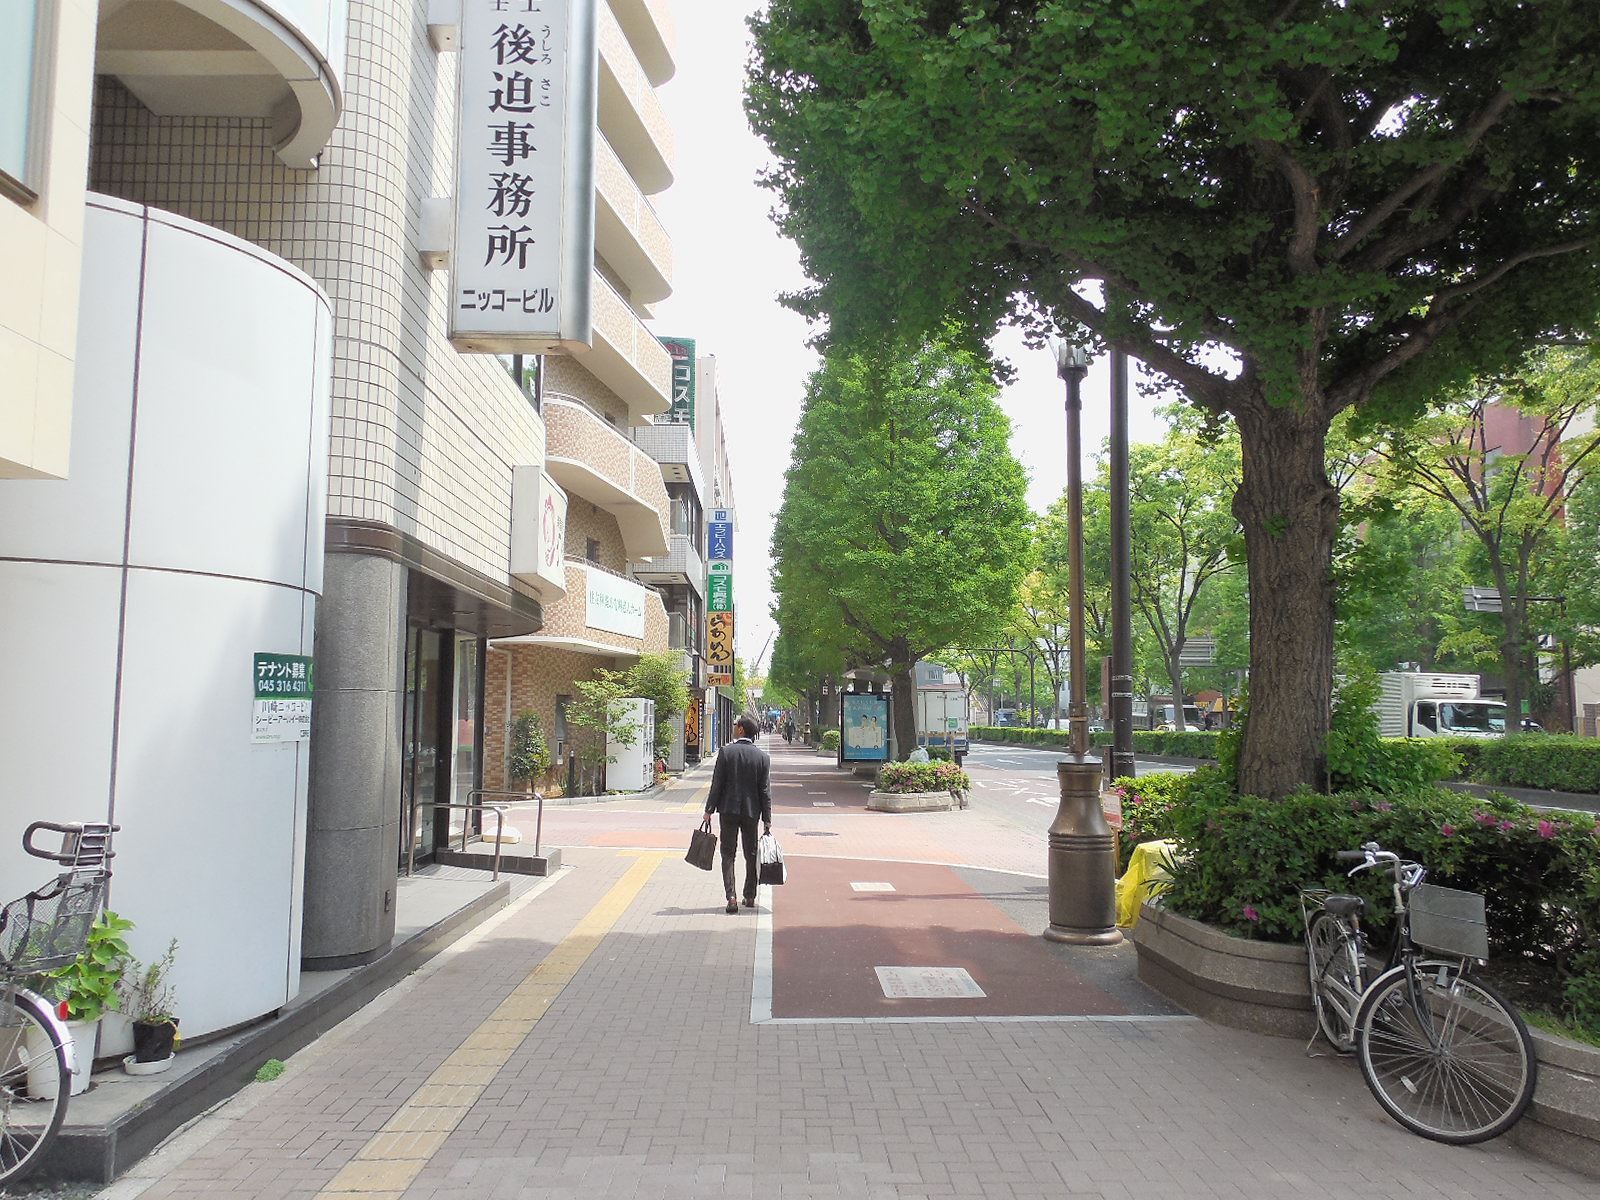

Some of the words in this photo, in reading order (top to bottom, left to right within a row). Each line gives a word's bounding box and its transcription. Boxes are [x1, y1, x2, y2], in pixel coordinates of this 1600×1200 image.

[541, 24, 552, 66] うしろ
[540, 78, 551, 107] さこ
[483, 22, 538, 271] 後迫事務所
[460, 286, 554, 314] ニッコービル
[257, 661, 306, 679] テナント募集
[258, 679, 275, 692] 045
[276, 680, 292, 692] 316
[292, 680, 306, 692] 4311
